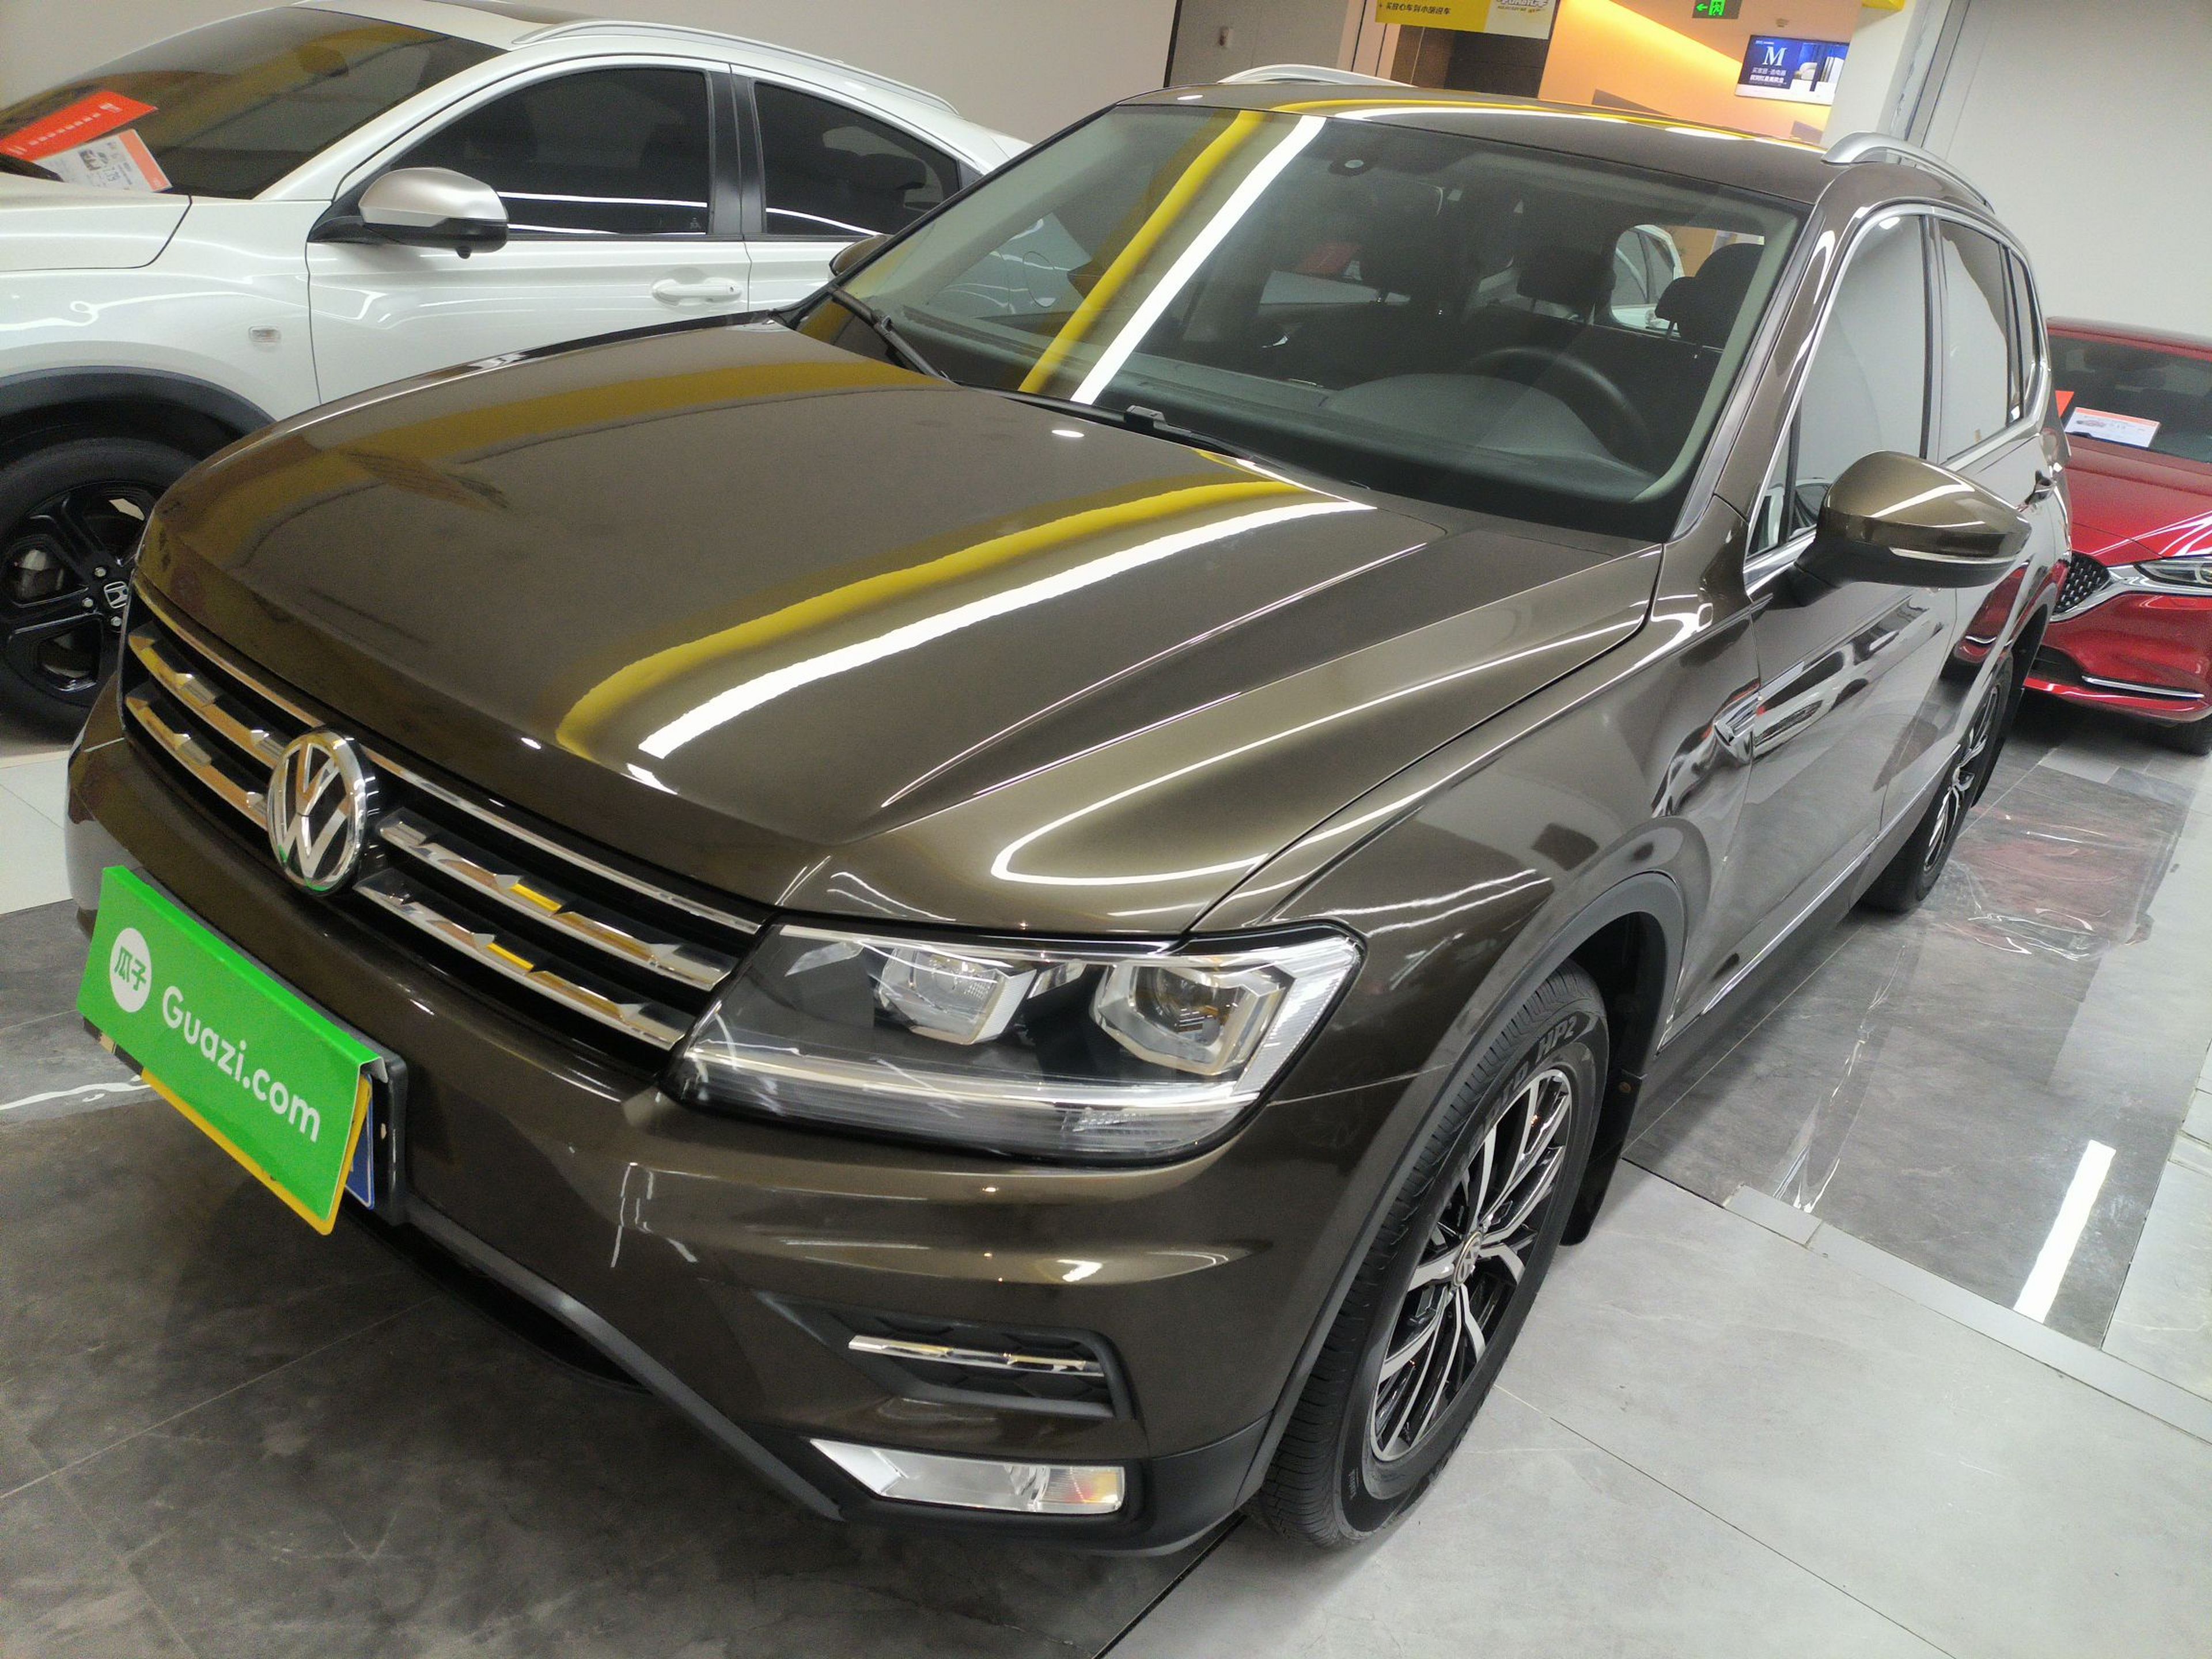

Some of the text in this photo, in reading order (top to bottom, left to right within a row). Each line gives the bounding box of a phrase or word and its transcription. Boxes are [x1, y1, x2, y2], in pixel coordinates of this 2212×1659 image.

[1762, 46, 1787, 66] M
[114, 945, 147, 991] 瓜子
[162, 985, 321, 1143] Guazi.com
[1535, 1015, 1578, 1065] HP2
